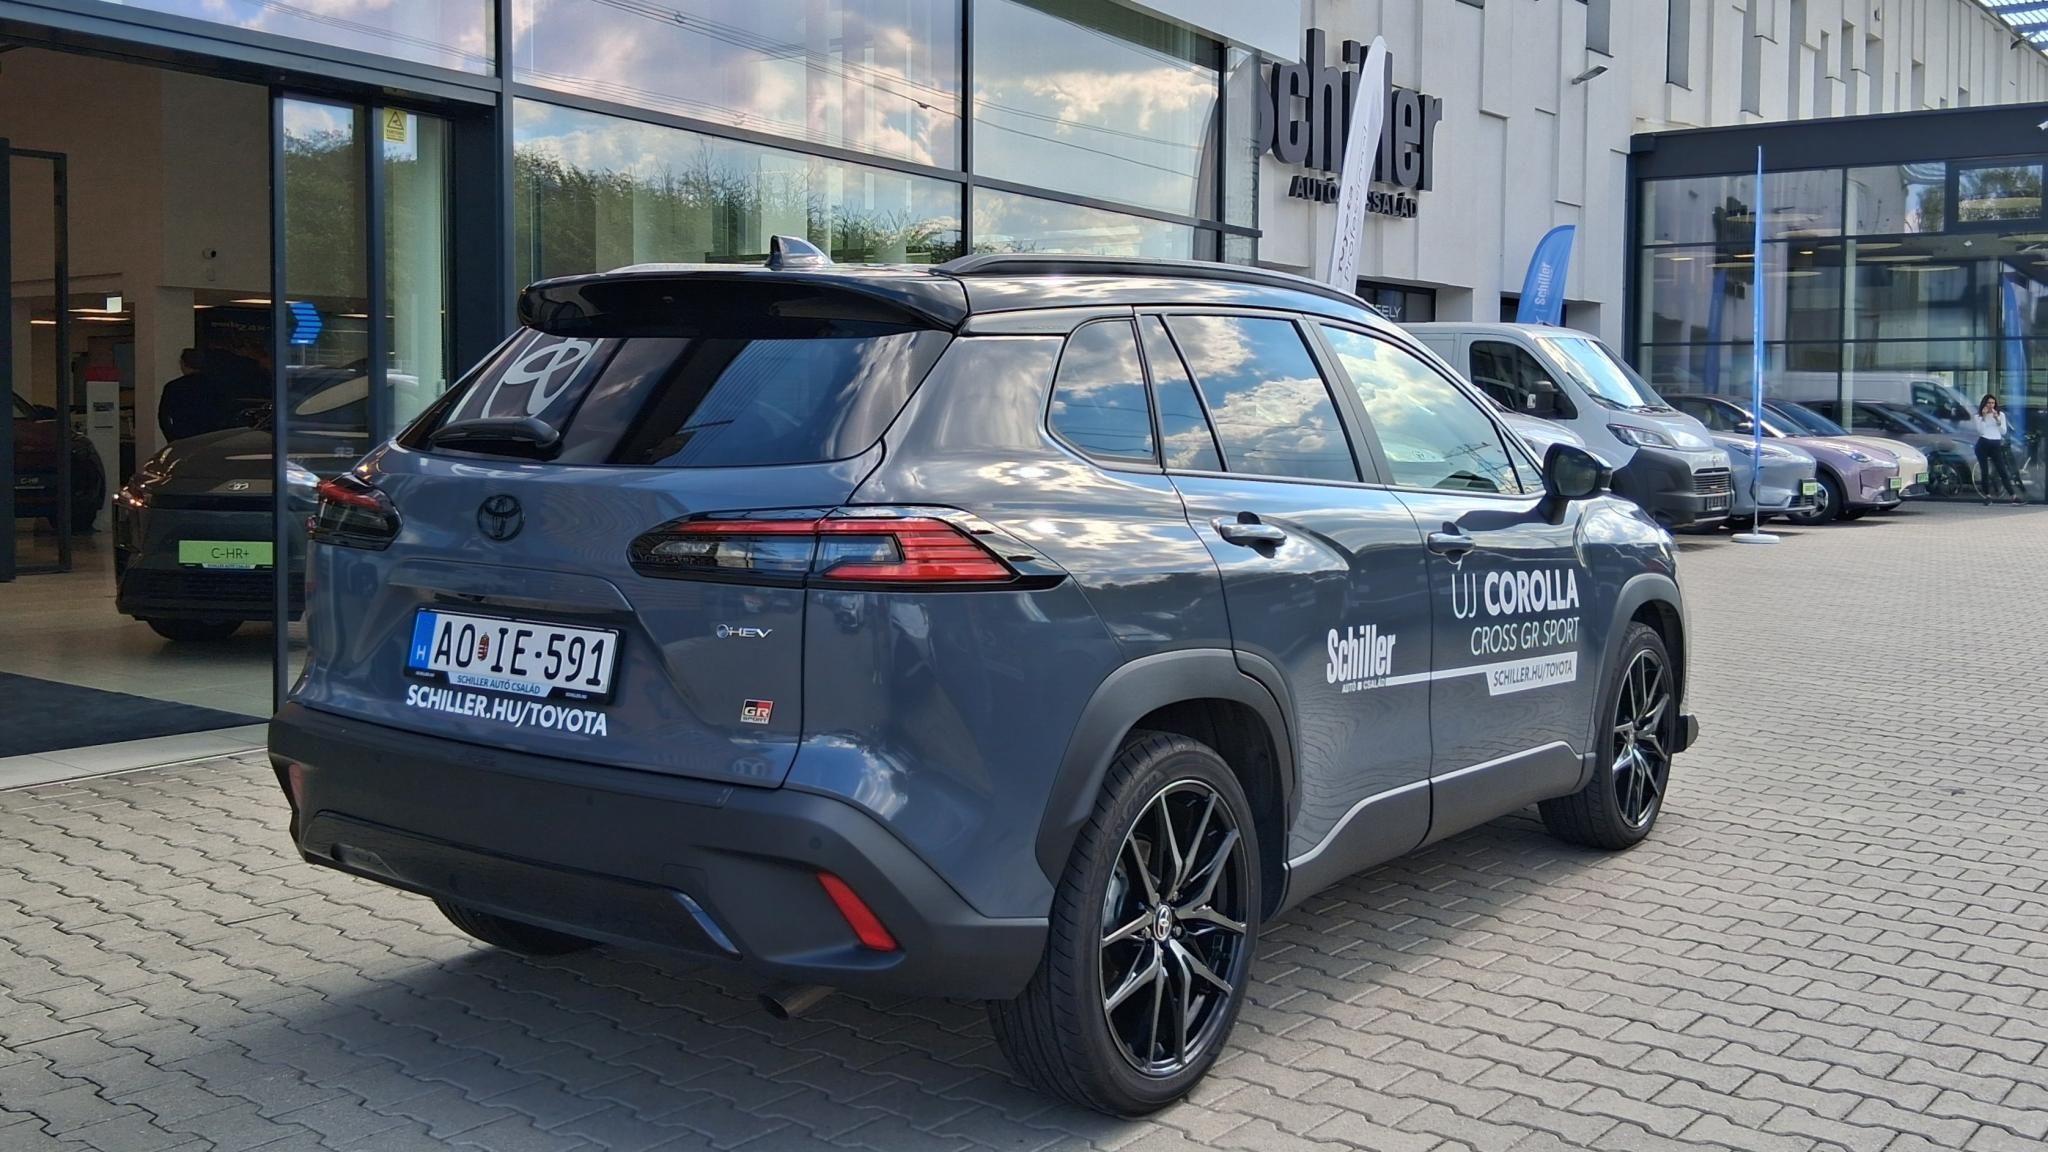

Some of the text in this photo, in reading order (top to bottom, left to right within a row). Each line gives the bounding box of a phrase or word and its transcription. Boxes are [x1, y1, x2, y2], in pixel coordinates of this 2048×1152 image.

[1258, 28, 1442, 191] chiler
[1289, 175, 1341, 204] AUTÓ
[1534, 261, 1551, 305] Schiller
[1371, 303, 1402, 318] ELY
[211, 547, 249, 559] C-HR+
[1484, 568, 1580, 616] COROLLA
[1470, 616, 1580, 656] CROSS GR SPORT
[416, 645, 427, 661] H
[1326, 624, 1396, 684] Schiller
[457, 674, 541, 695] SCHILLER AUTÓ CSALÁD
[1493, 659, 1573, 688] SCHILLER.HU/TOYOTA
[406, 684, 608, 737] SCHILLER.HU/TOYOTA
[744, 706, 769, 717] GR
